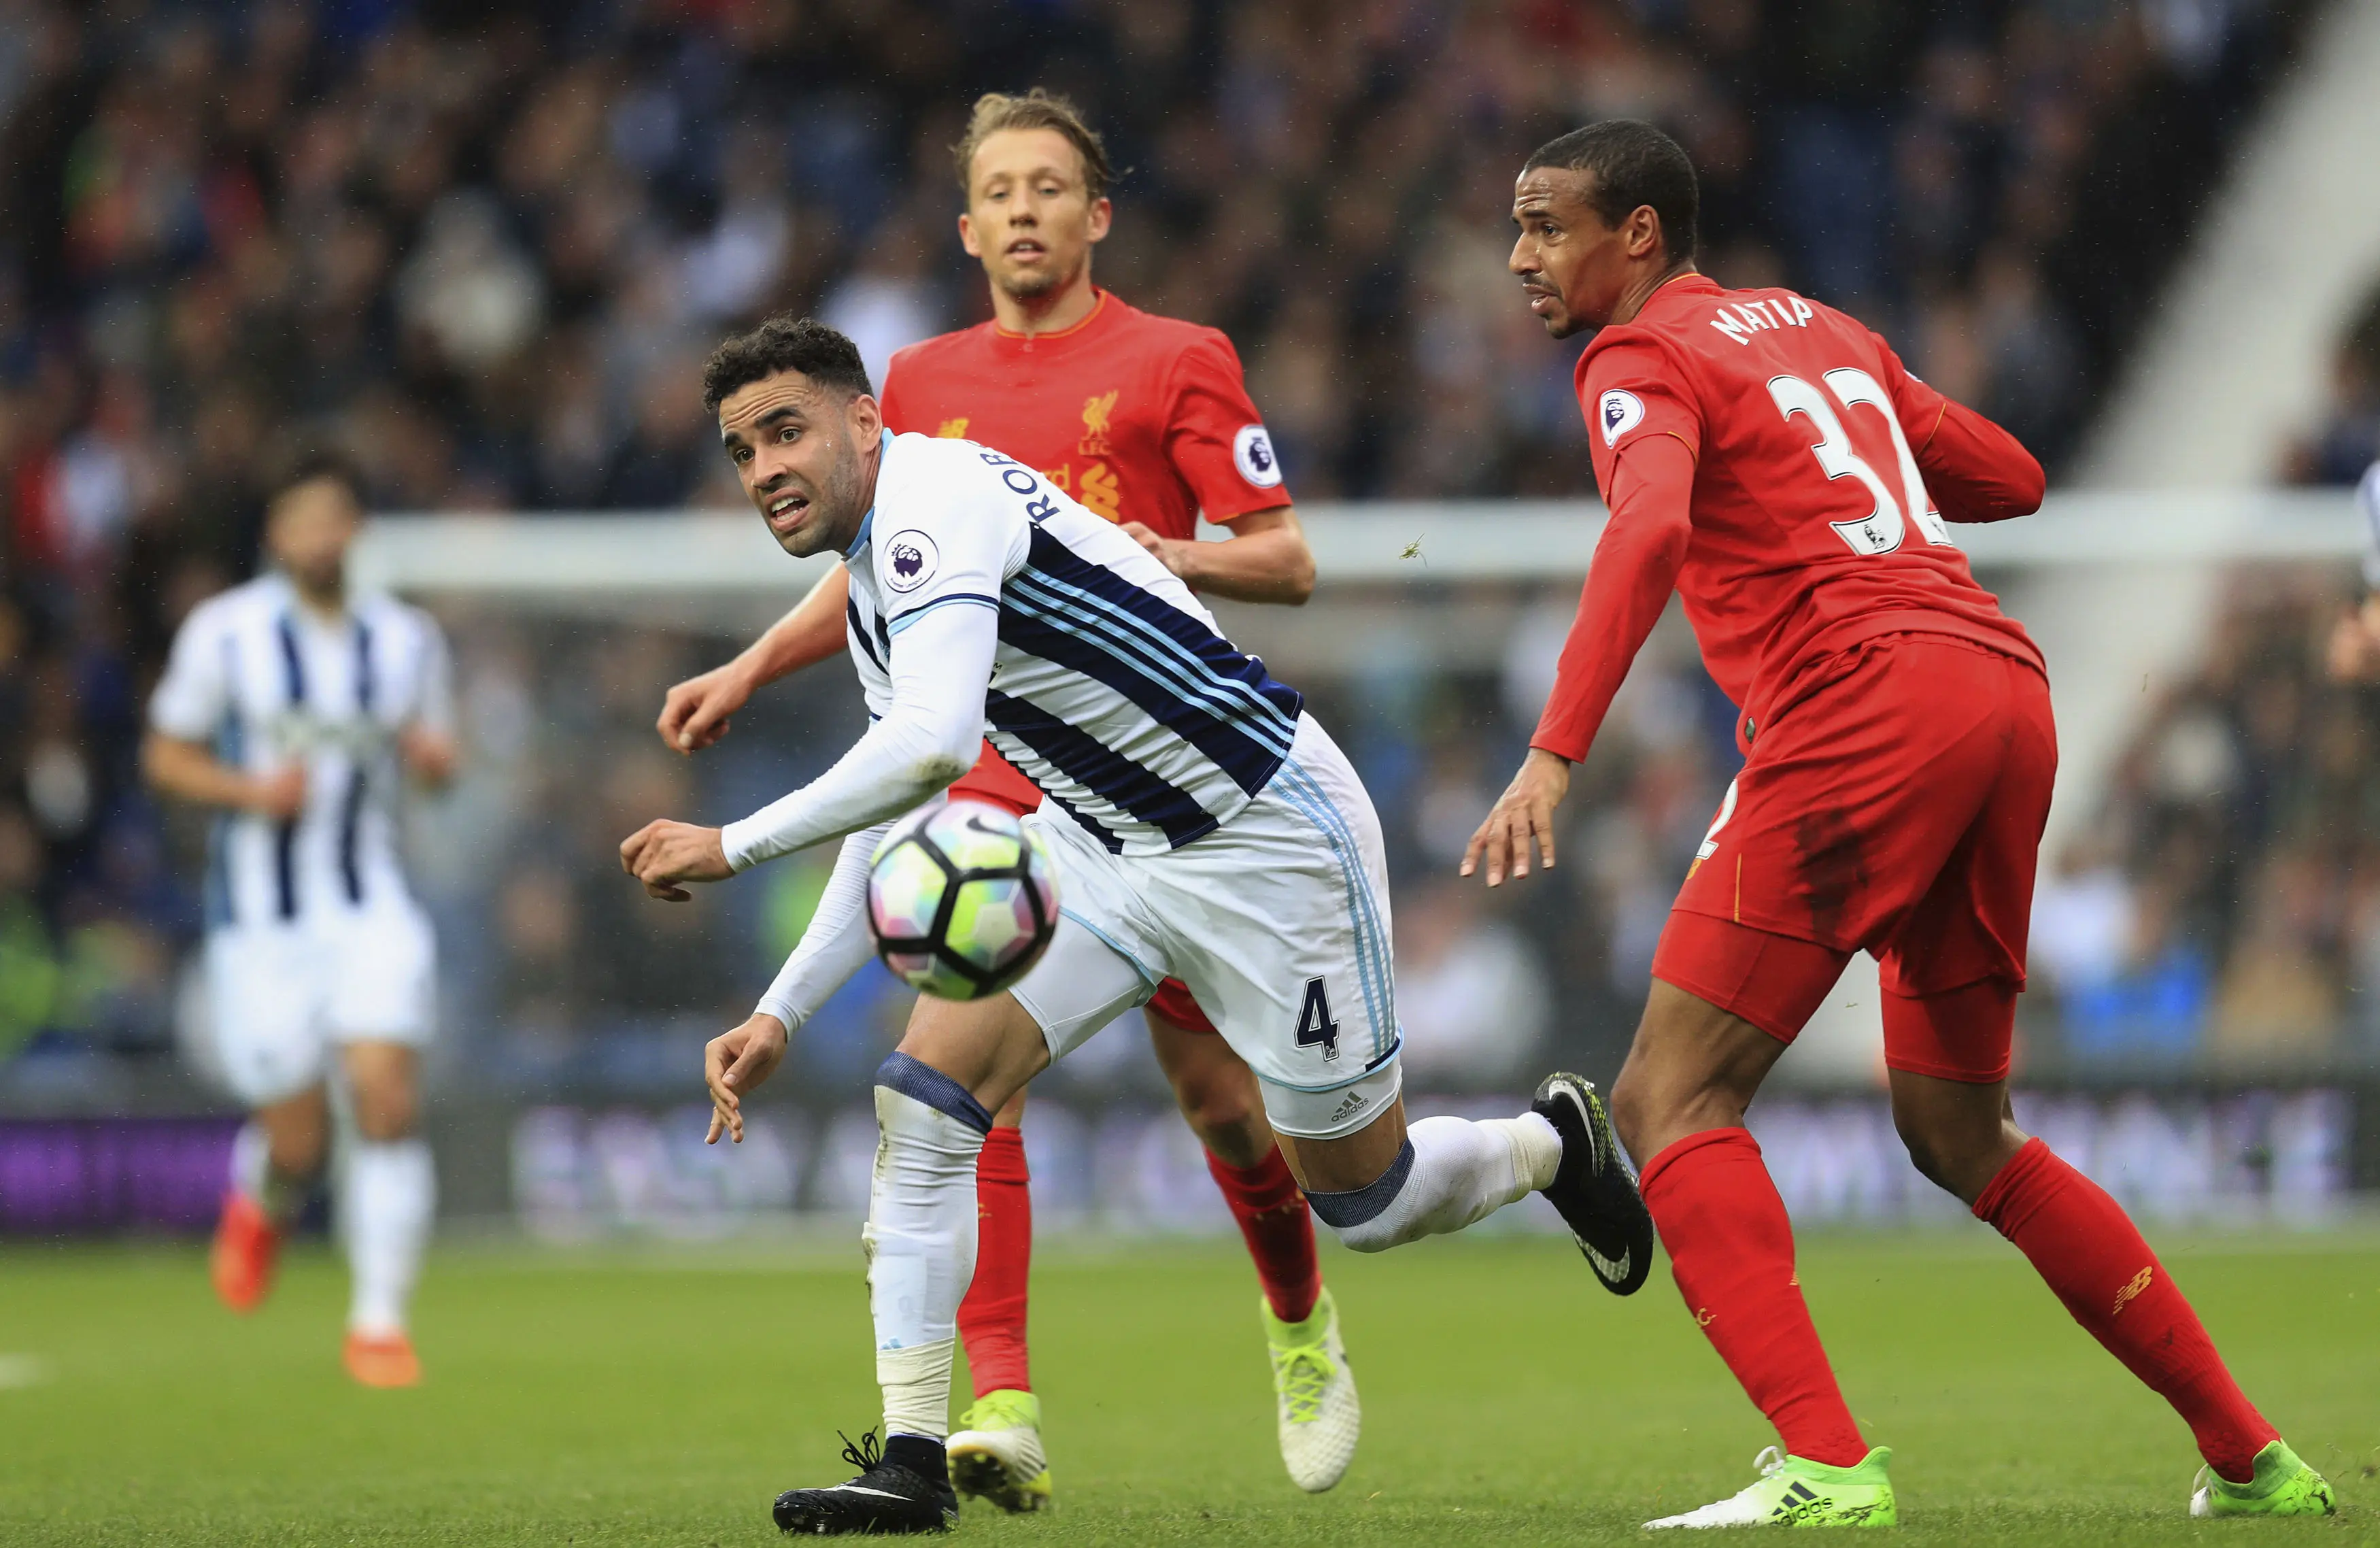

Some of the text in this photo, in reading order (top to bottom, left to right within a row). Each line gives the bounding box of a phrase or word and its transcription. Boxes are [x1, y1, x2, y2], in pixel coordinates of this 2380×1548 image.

[1710, 297, 1813, 346] MATIP
[965, 441, 1061, 524] ROB
[1766, 367, 1954, 556] 32
[1294, 975, 1340, 1062] 4
[1331, 1098, 1369, 1122] adidas
[1769, 1498, 1833, 1526] didas
